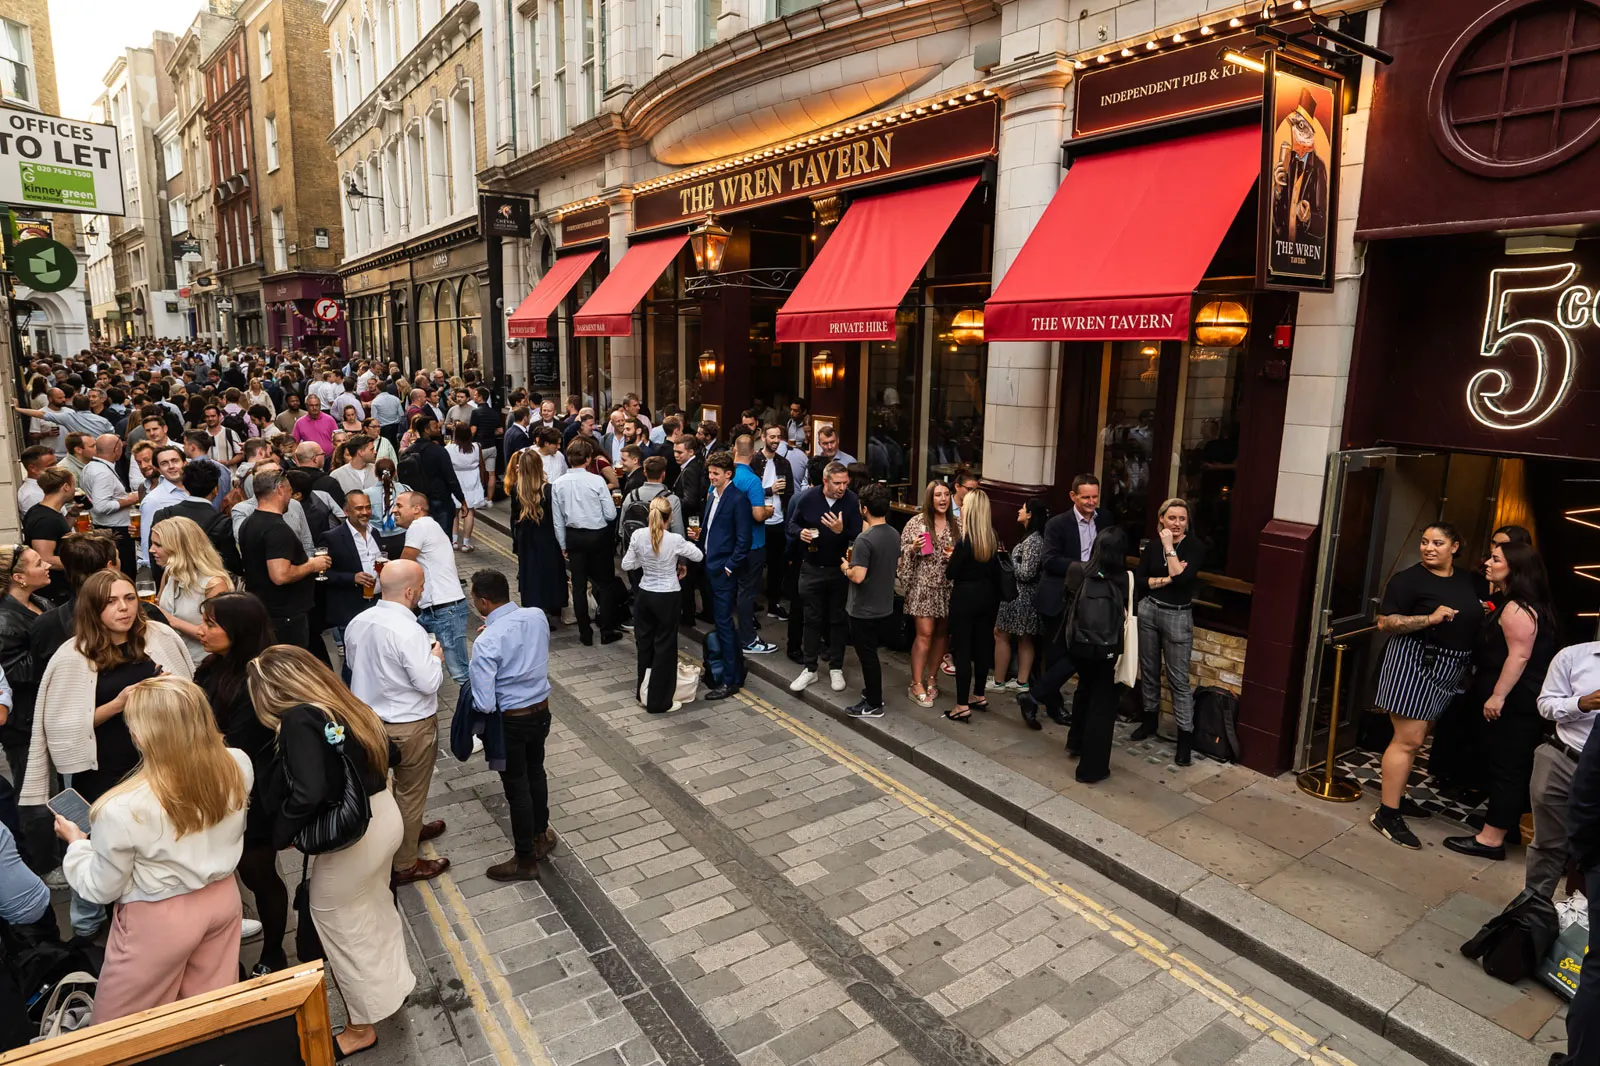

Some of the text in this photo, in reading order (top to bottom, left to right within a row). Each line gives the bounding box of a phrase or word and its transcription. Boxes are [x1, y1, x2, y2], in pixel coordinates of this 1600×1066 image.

[1100, 78, 1181, 107] INDEPENDENT
[1182, 71, 1207, 88] PUB
[1209, 67, 1219, 81] &
[9, 115, 94, 141] OFFICES
[0, 132, 111, 169] TO LET
[36, 165, 51, 173] 020
[679, 132, 894, 215] THE WREN TAVERN
[23, 183, 94, 200] kinneygreen
[1275, 240, 1321, 260] THE WREN
[829, 320, 888, 334] PRIVATE HIRE
[1031, 313, 1174, 331] THE WREN TAVERN
